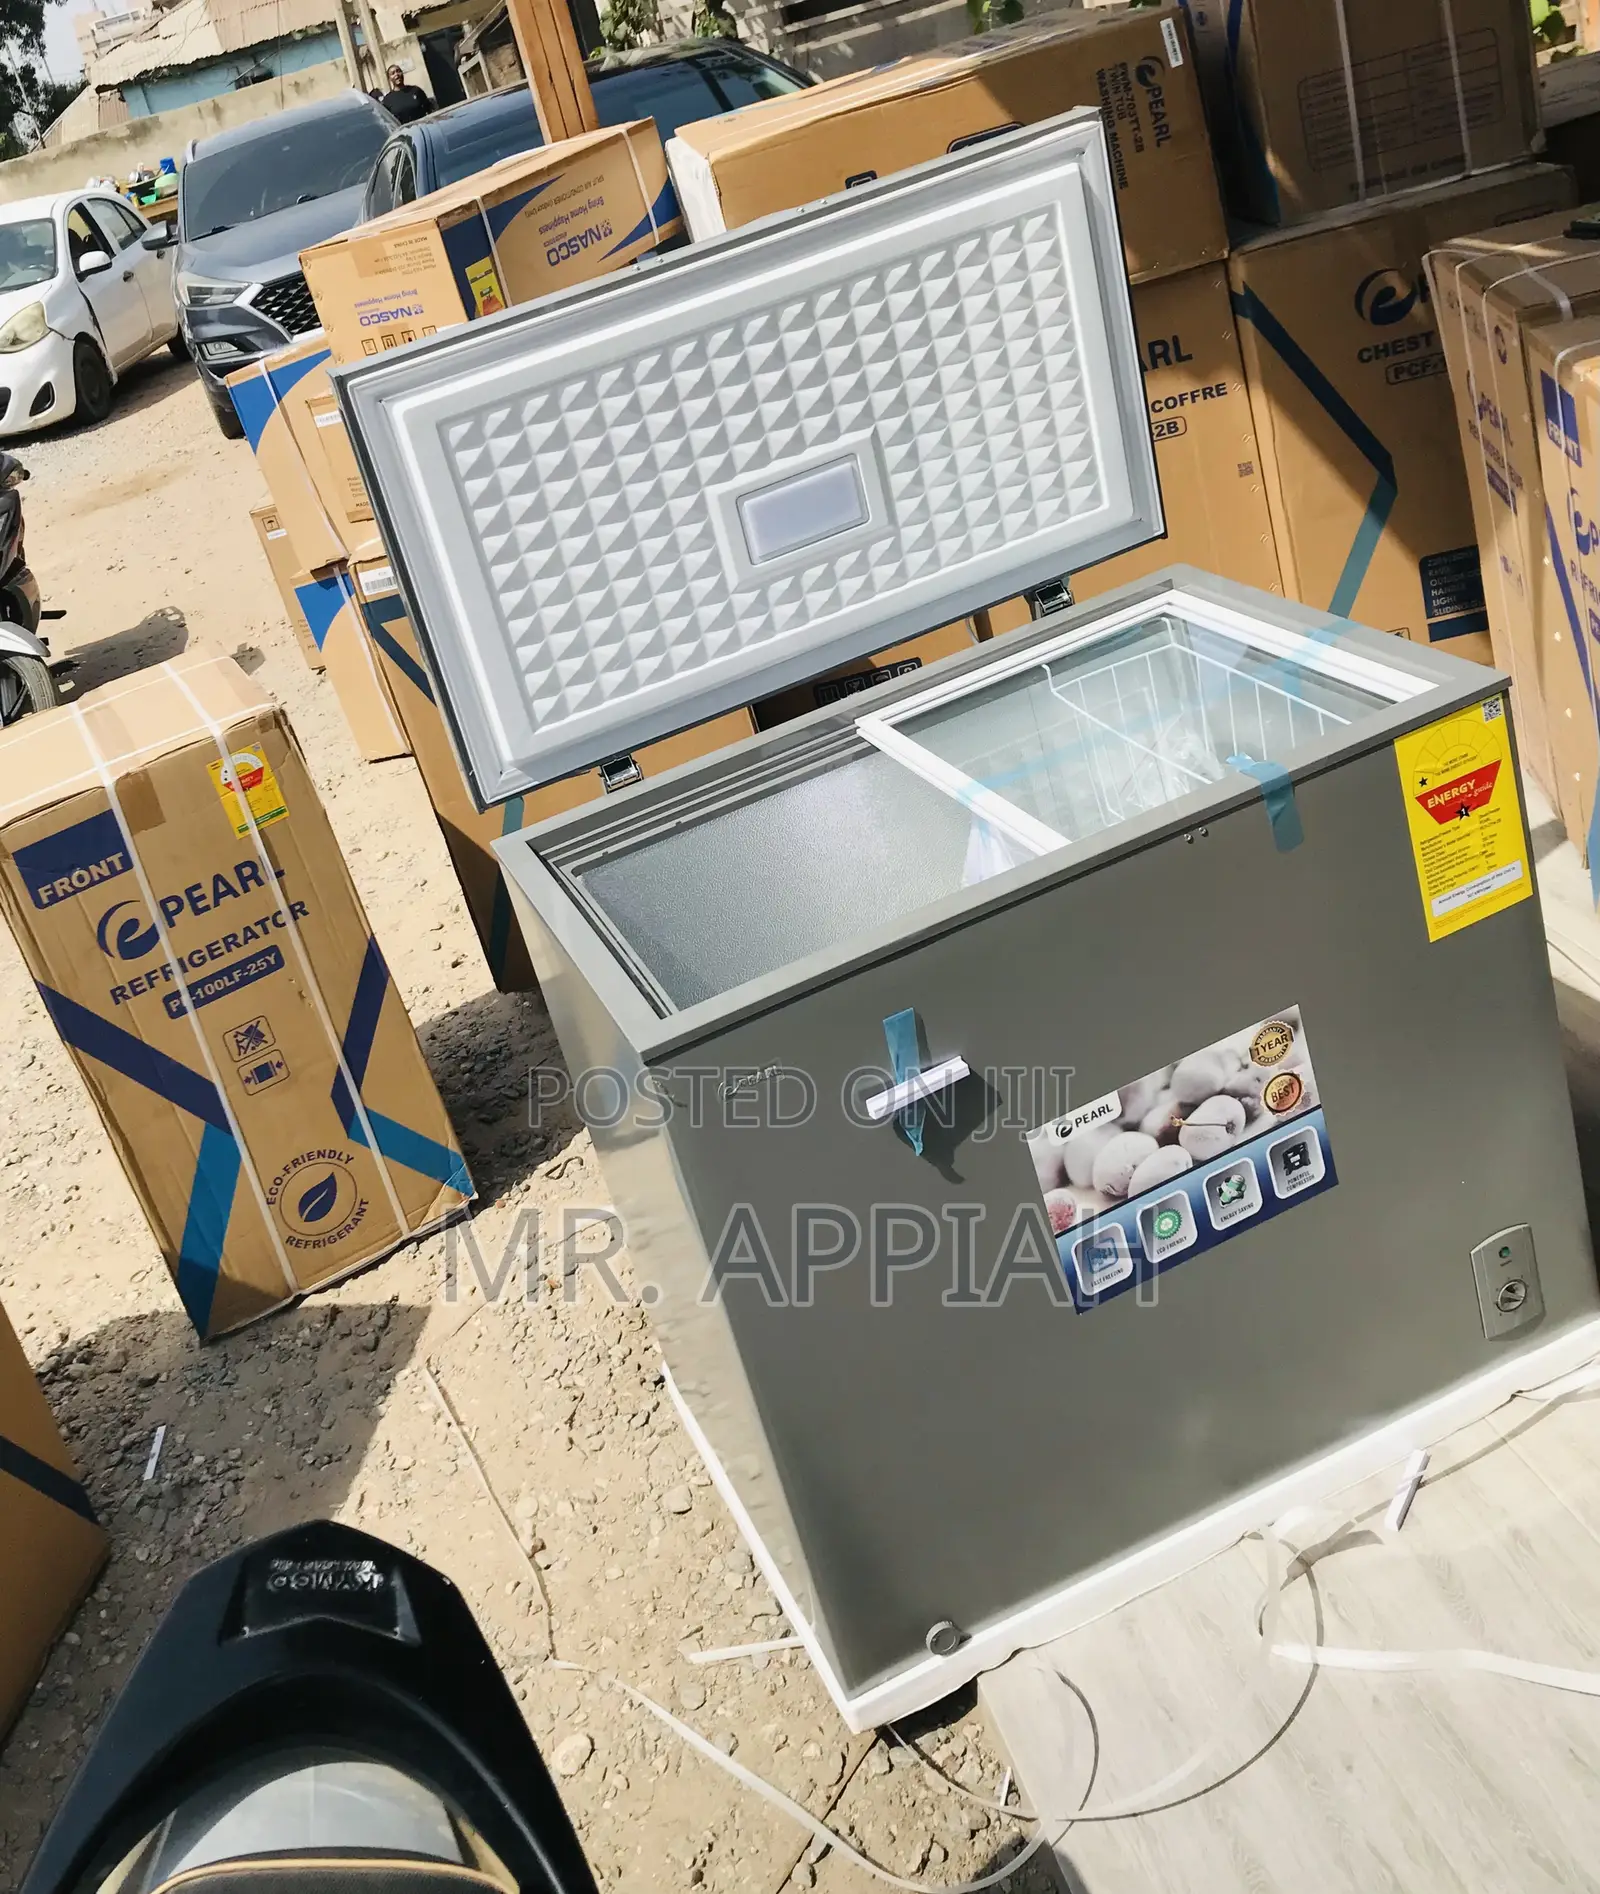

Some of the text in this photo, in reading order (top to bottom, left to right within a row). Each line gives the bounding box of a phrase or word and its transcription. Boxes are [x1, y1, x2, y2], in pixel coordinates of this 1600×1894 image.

[1107, 67, 1127, 121] TWIN TUB
[1096, 68, 1129, 190] WASHING MACHINE
[1146, 86, 1172, 148] PEARL
[538, 195, 605, 236] Bring Home Happiness
[553, 184, 584, 206] CONDITIONER
[546, 224, 602, 267] NASCO
[359, 305, 413, 327] NASCO
[1357, 330, 1435, 364] CHEST
[1150, 382, 1229, 414] COFFRE
[1427, 779, 1493, 809] ENERGY guide
[37, 851, 125, 905] FRONT
[160, 858, 286, 929] PEARL
[109, 901, 310, 1006] REFRIGERATOR
[168, 952, 277, 1013] P-100LF-25Y
[1255, 1033, 1289, 1056] 1 YEAR
[1270, 1082, 1295, 1103] BEST
[1074, 1103, 1114, 1128] PEARL
[265, 1148, 355, 1206] ECO-FRIENDLY
[285, 1197, 370, 1250] REFRIGERANT
